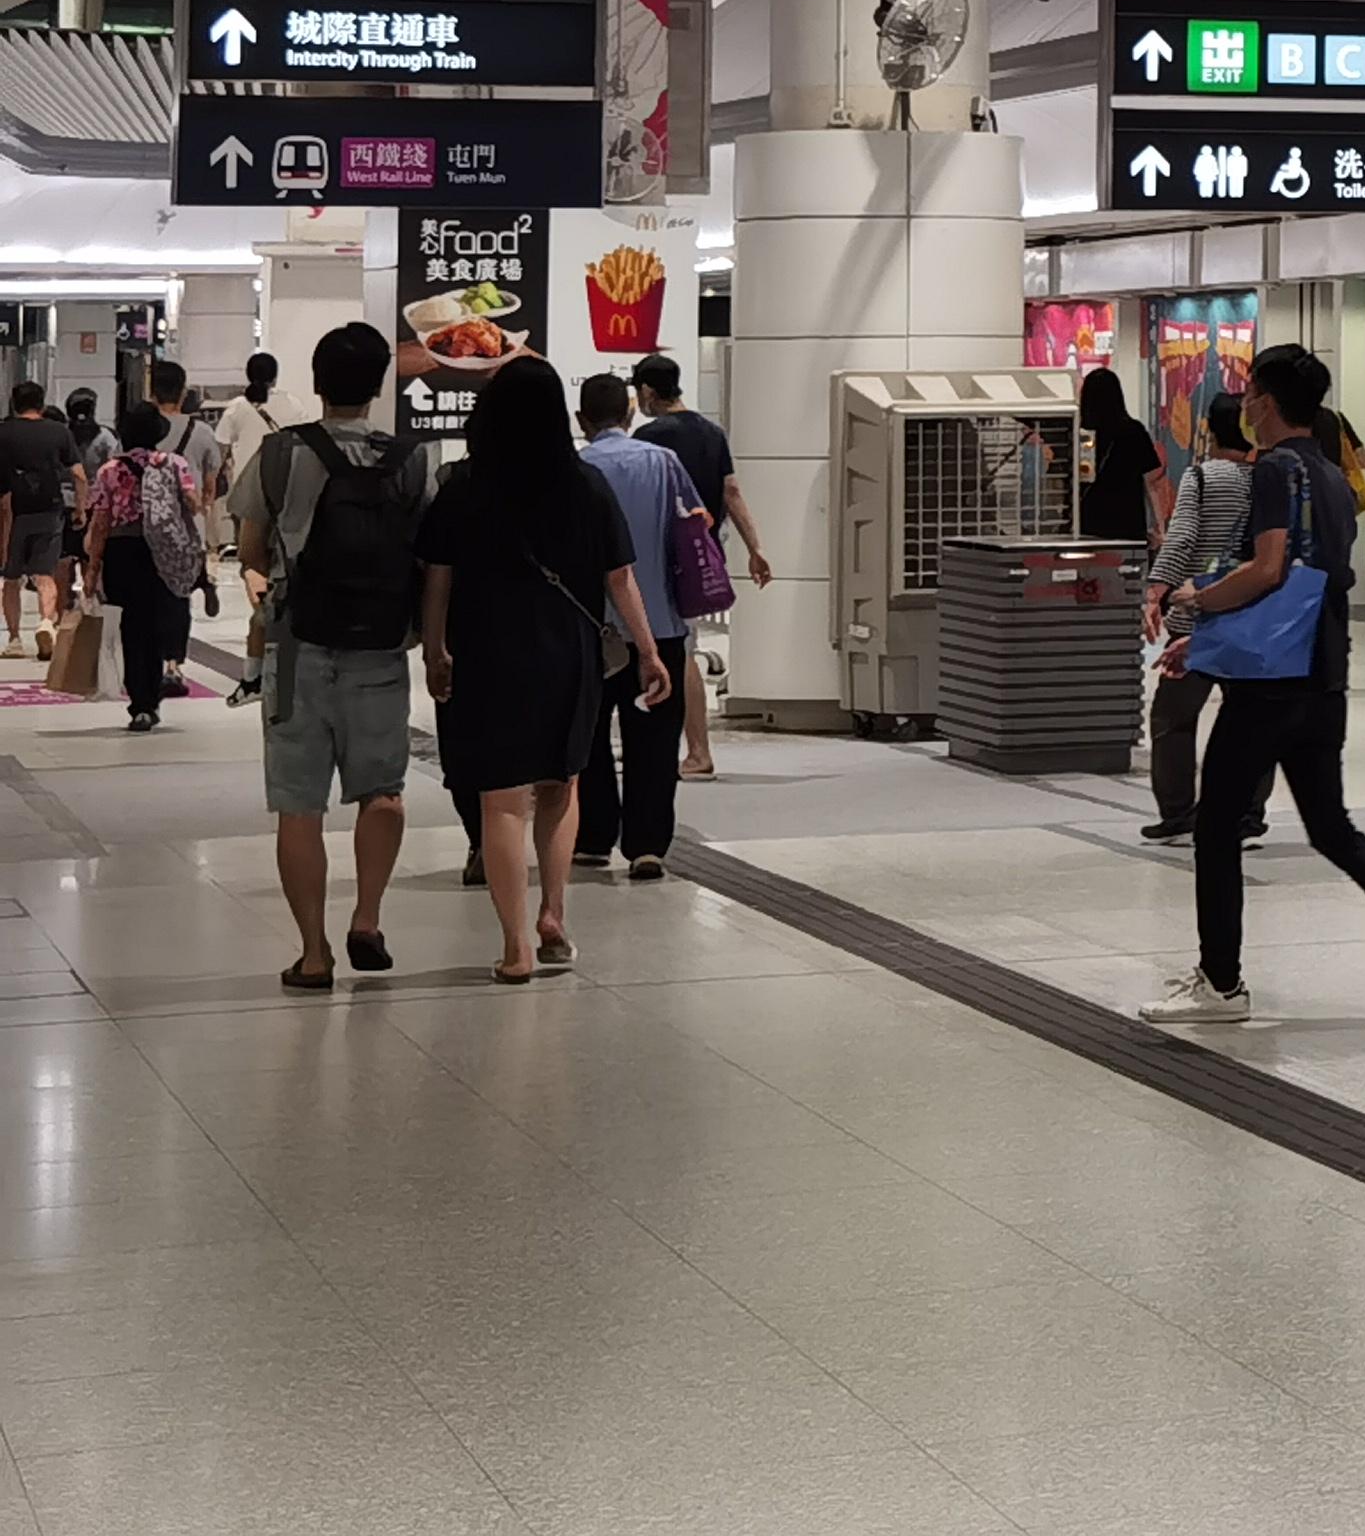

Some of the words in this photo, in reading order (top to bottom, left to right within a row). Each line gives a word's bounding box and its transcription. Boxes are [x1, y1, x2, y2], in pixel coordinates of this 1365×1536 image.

[286, 11, 459, 48] 城際直通車
[285, 49, 359, 71] Intercity
[359, 50, 433, 73] Through
[433, 51, 476, 69] Train
[1202, 30, 1244, 69] 出
[1280, 42, 1304, 78] B
[1335, 44, 1362, 80] C
[1202, 68, 1243, 83] EXIT
[448, 144, 495, 168] 屯門
[346, 170, 378, 183] West
[380, 171, 404, 183] Rail
[405, 171, 433, 184] Line
[446, 171, 476, 184] Tuen
[477, 172, 507, 184] Mun
[426, 258, 522, 282] 美食廣場
